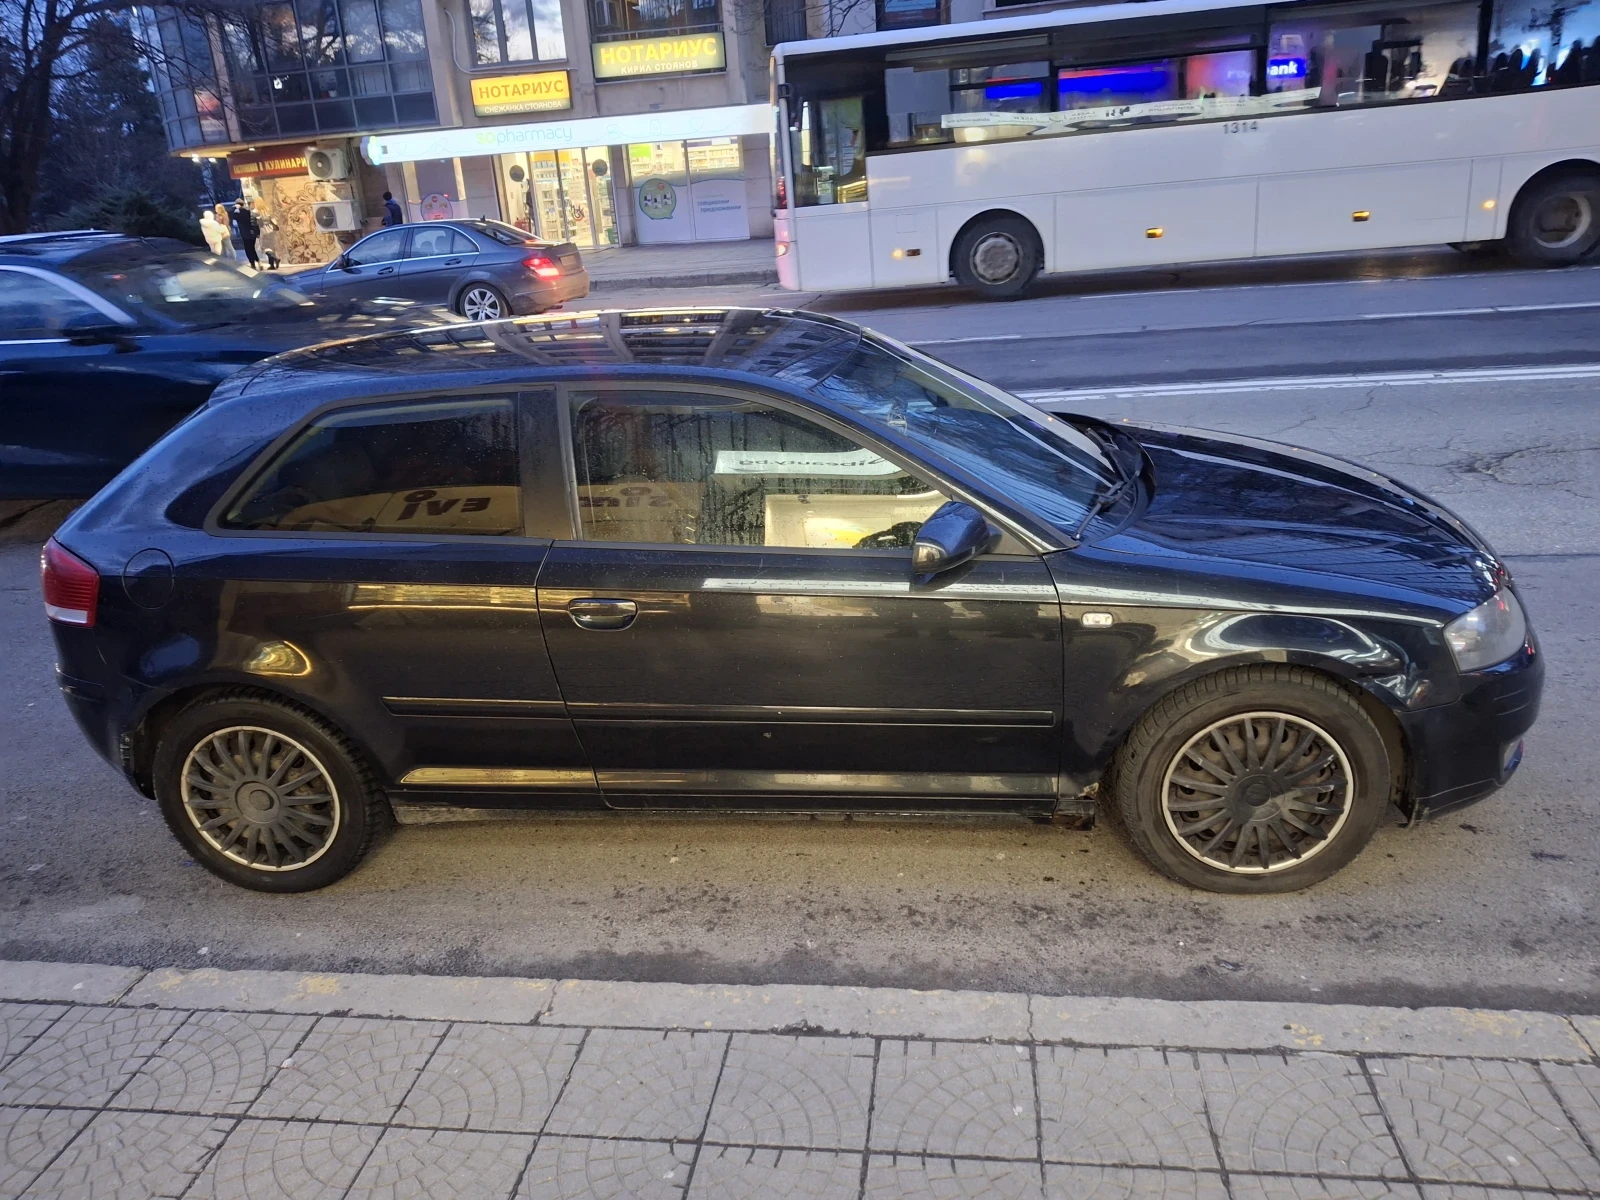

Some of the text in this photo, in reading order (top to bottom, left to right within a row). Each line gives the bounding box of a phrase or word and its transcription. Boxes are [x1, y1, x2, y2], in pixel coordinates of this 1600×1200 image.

[600, 37, 717, 65] НОТАРИУС
[621, 60, 698, 75] КИРИЛ СТОЯНОВ
[478, 80, 564, 99] НОТАРИУС
[484, 100, 562, 114] СНЕЖАНКА СТОЯНОВА
[1222, 121, 1258, 135] 1314
